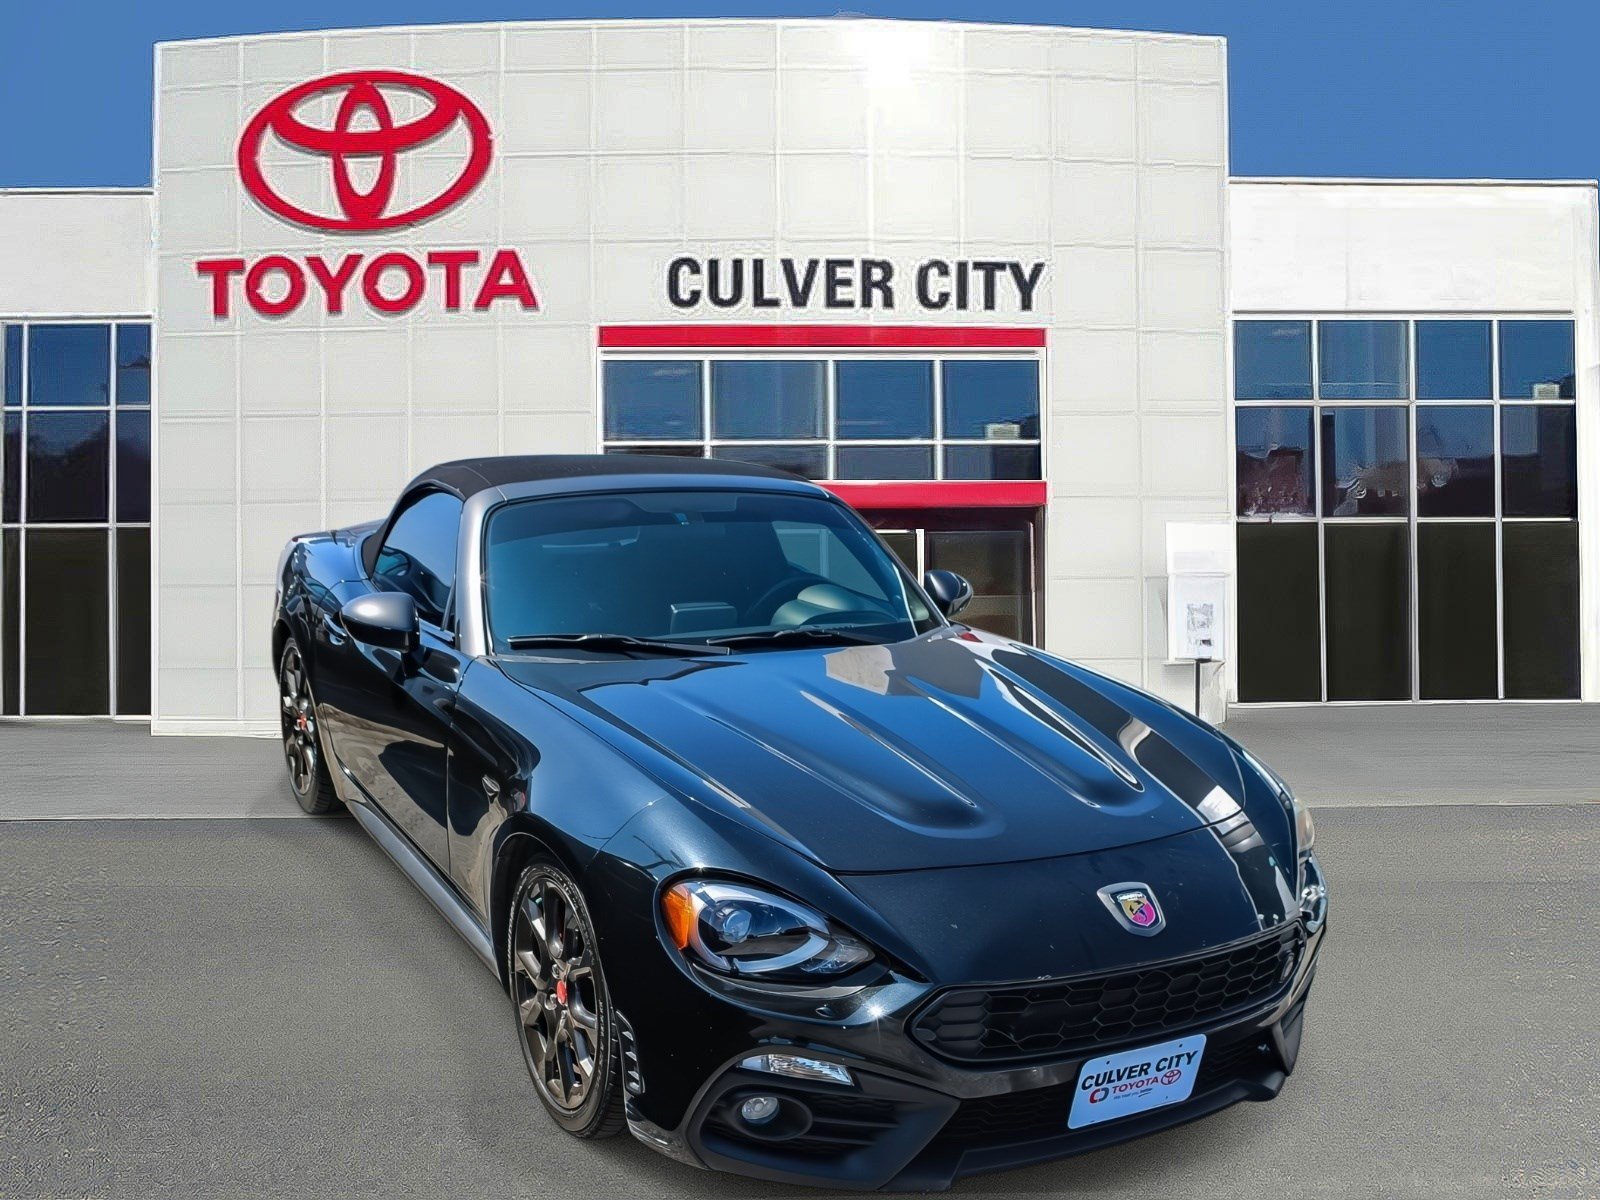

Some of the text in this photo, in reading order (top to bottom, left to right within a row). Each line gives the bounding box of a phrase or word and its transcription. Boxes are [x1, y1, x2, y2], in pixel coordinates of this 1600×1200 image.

[196, 249, 540, 318] TOYOTA
[667, 258, 1045, 311] CULVER CITY
[1082, 1051, 1198, 1091] CULVER CITY
[1112, 1076, 1159, 1094] TOYOTA
